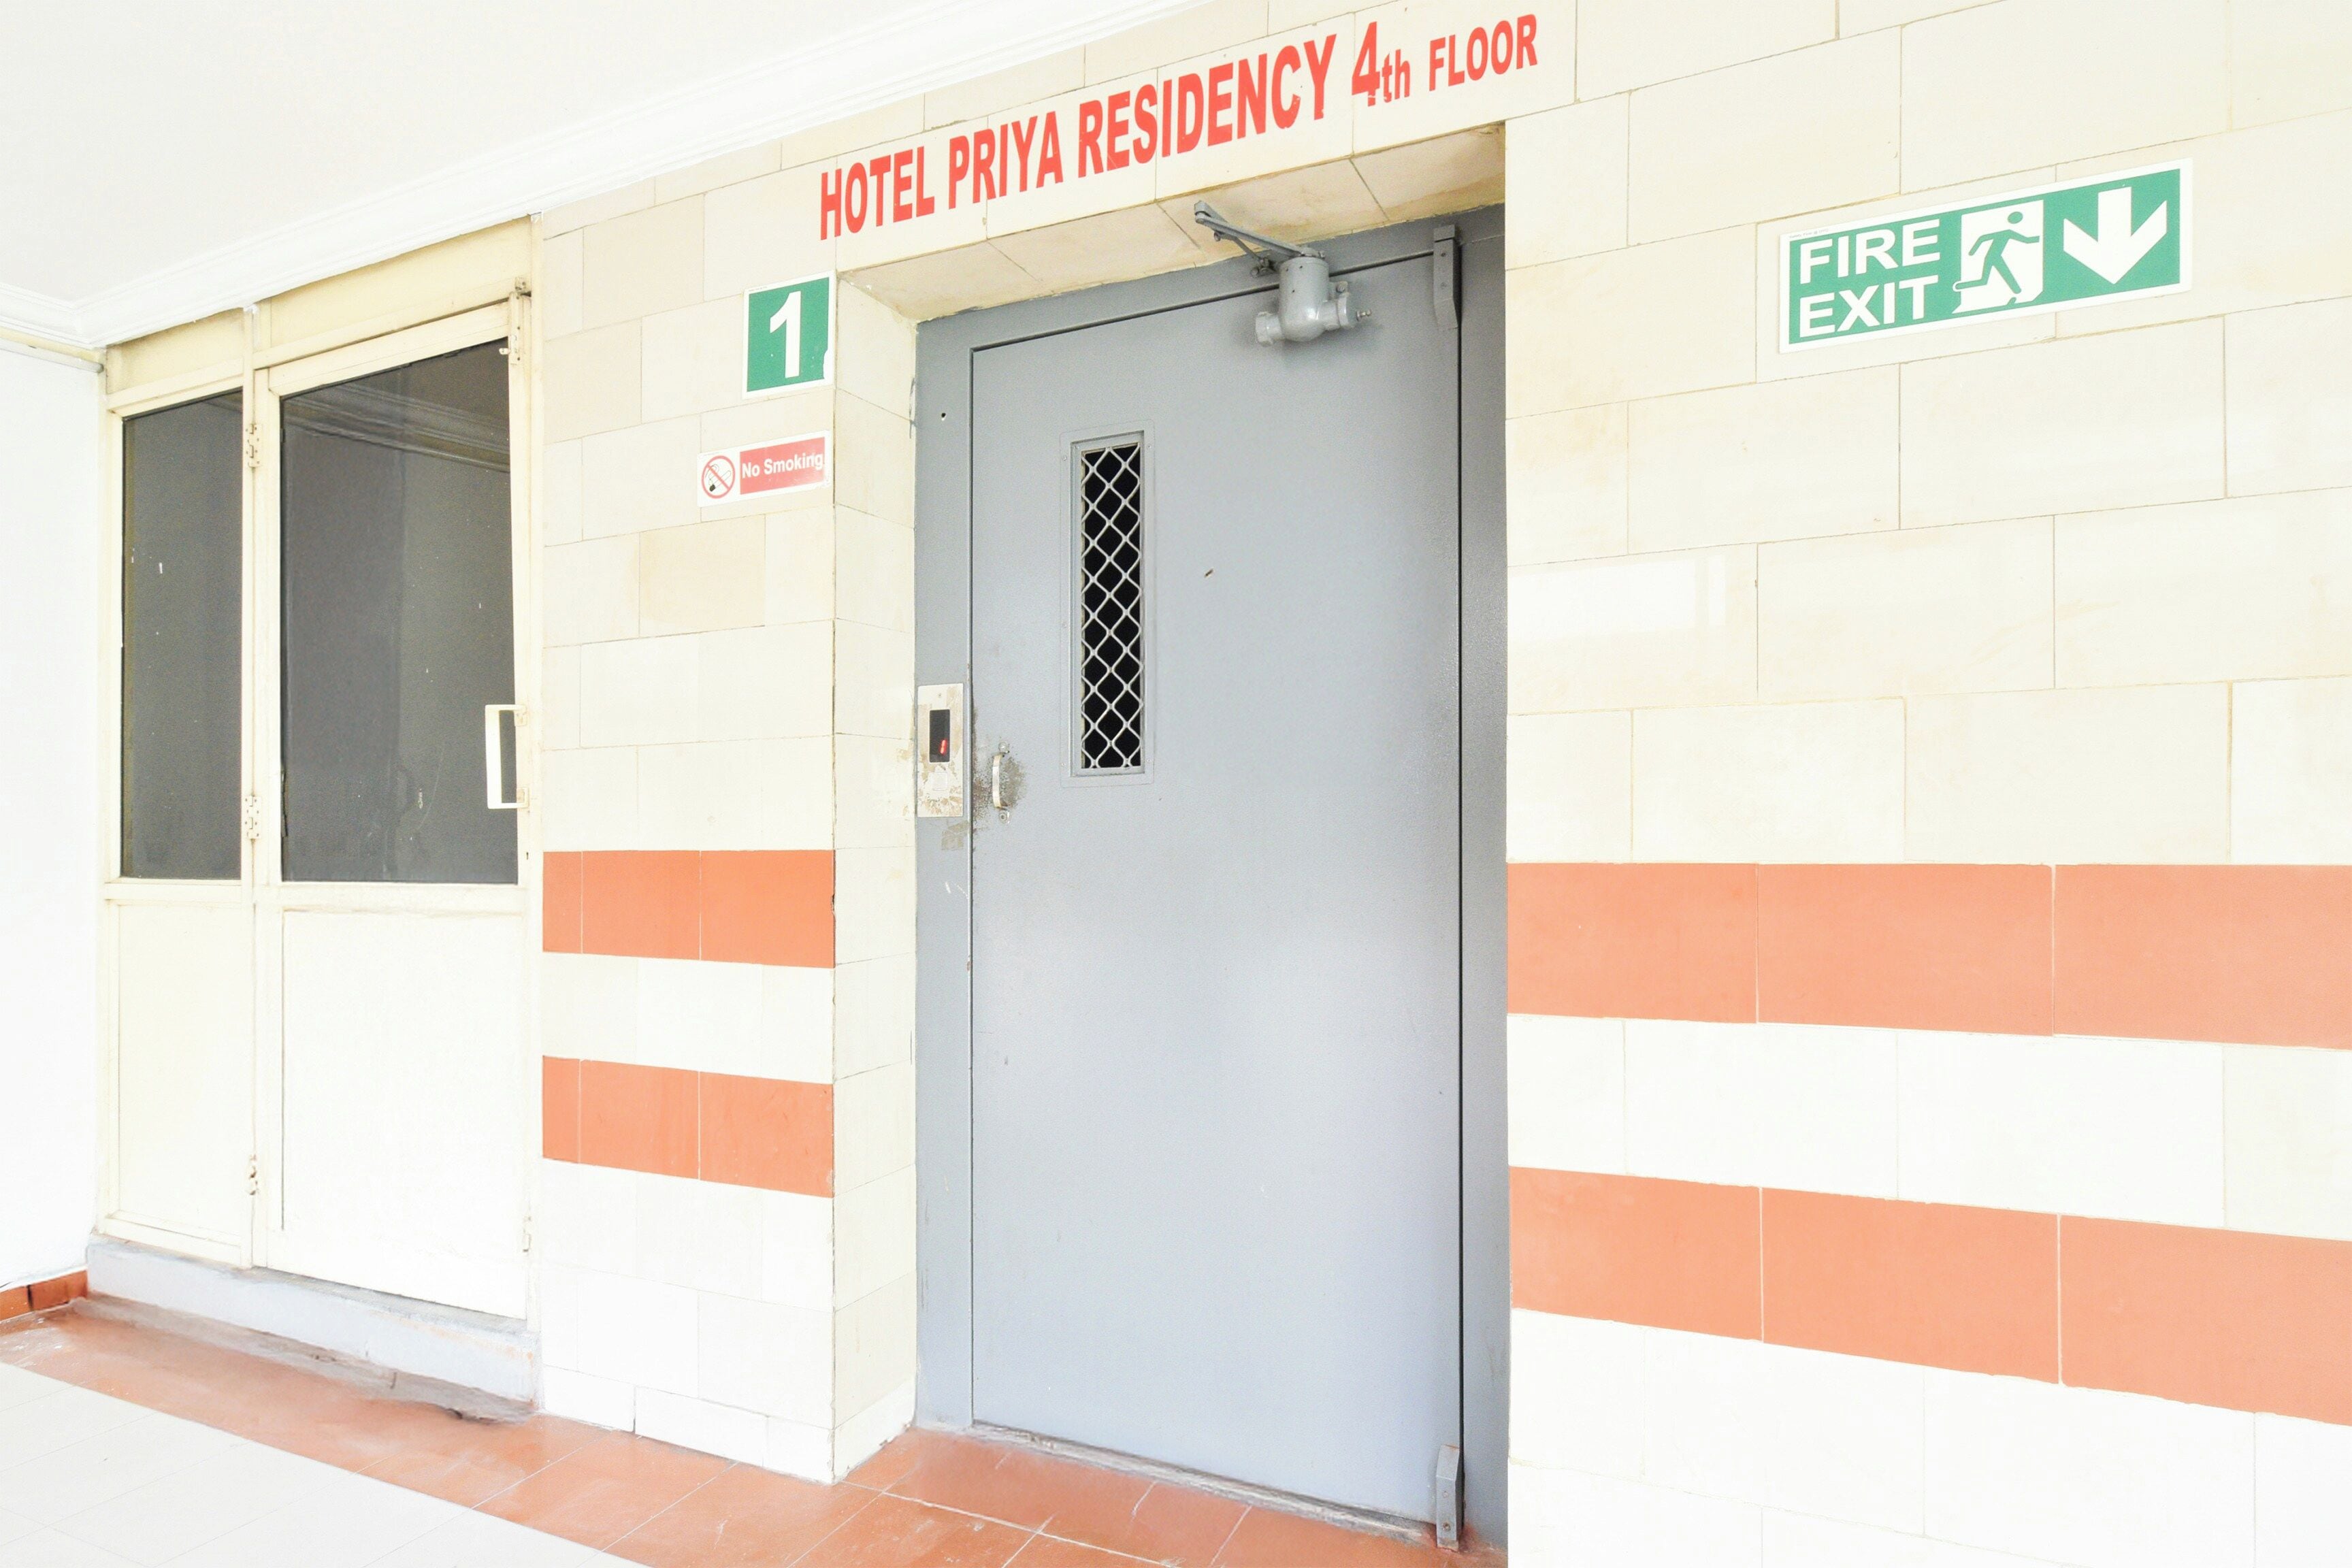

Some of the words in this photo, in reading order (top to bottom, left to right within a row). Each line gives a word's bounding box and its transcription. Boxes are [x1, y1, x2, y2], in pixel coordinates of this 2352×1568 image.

[819, 146, 936, 241] HOTEL
[948, 110, 1064, 210] PRIYA
[1077, 33, 1337, 178] RESIDENCY
[1351, 20, 1411, 107] 4th
[1428, 13, 1539, 91] FLOOR
[1799, 218, 1941, 284] FIRE
[769, 290, 802, 379] 1
[1799, 274, 1940, 338] EXIT
[741, 461, 760, 479] No
[763, 452, 823, 476] Smoking
